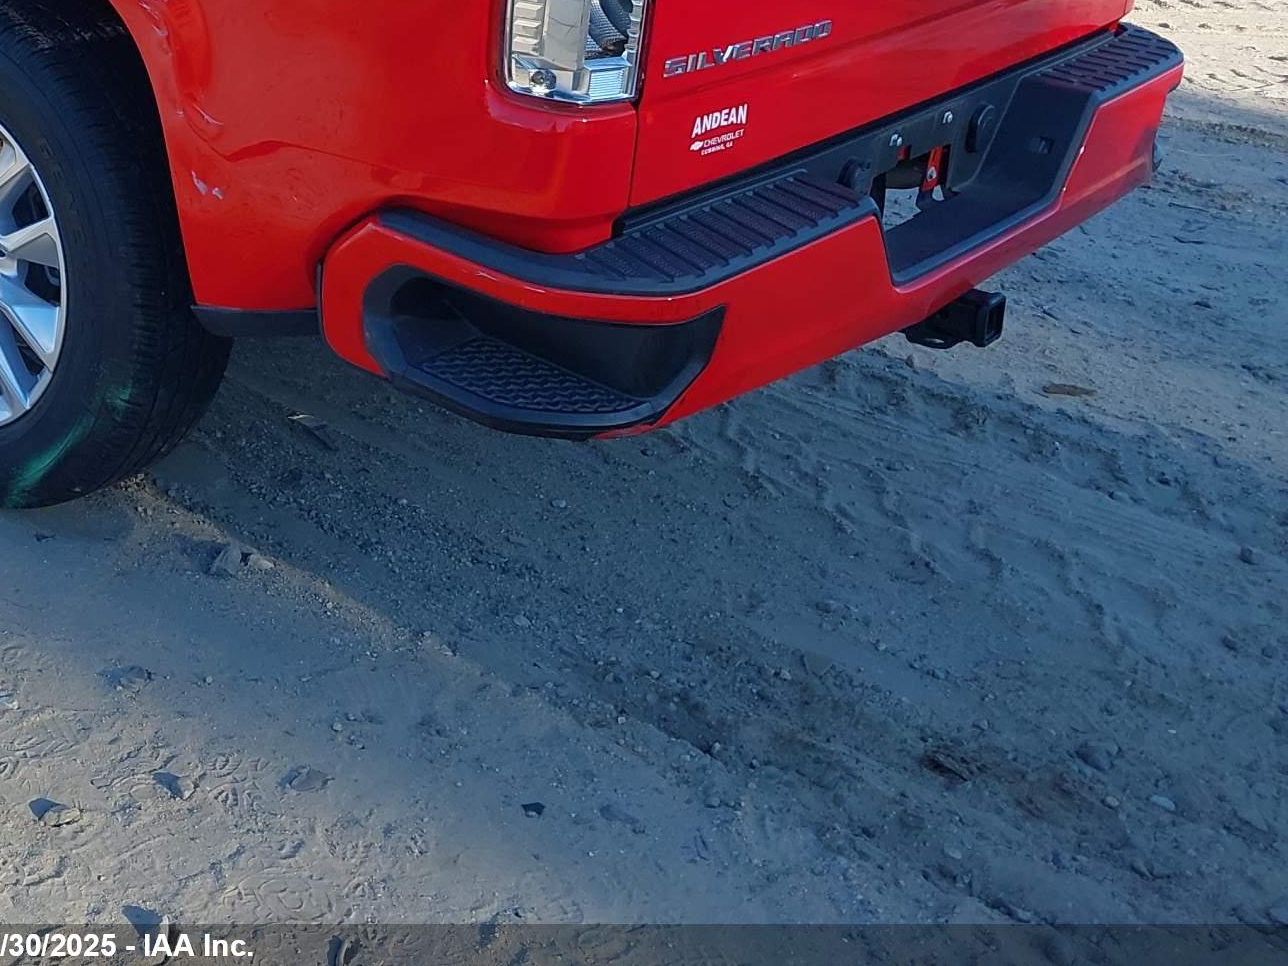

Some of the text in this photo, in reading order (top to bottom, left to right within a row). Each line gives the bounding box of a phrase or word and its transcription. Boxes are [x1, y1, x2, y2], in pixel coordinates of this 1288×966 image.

[663, 19, 833, 78] SILVERADO
[691, 103, 748, 138] ANDEAN
[703, 128, 745, 148] CHEVROLET
